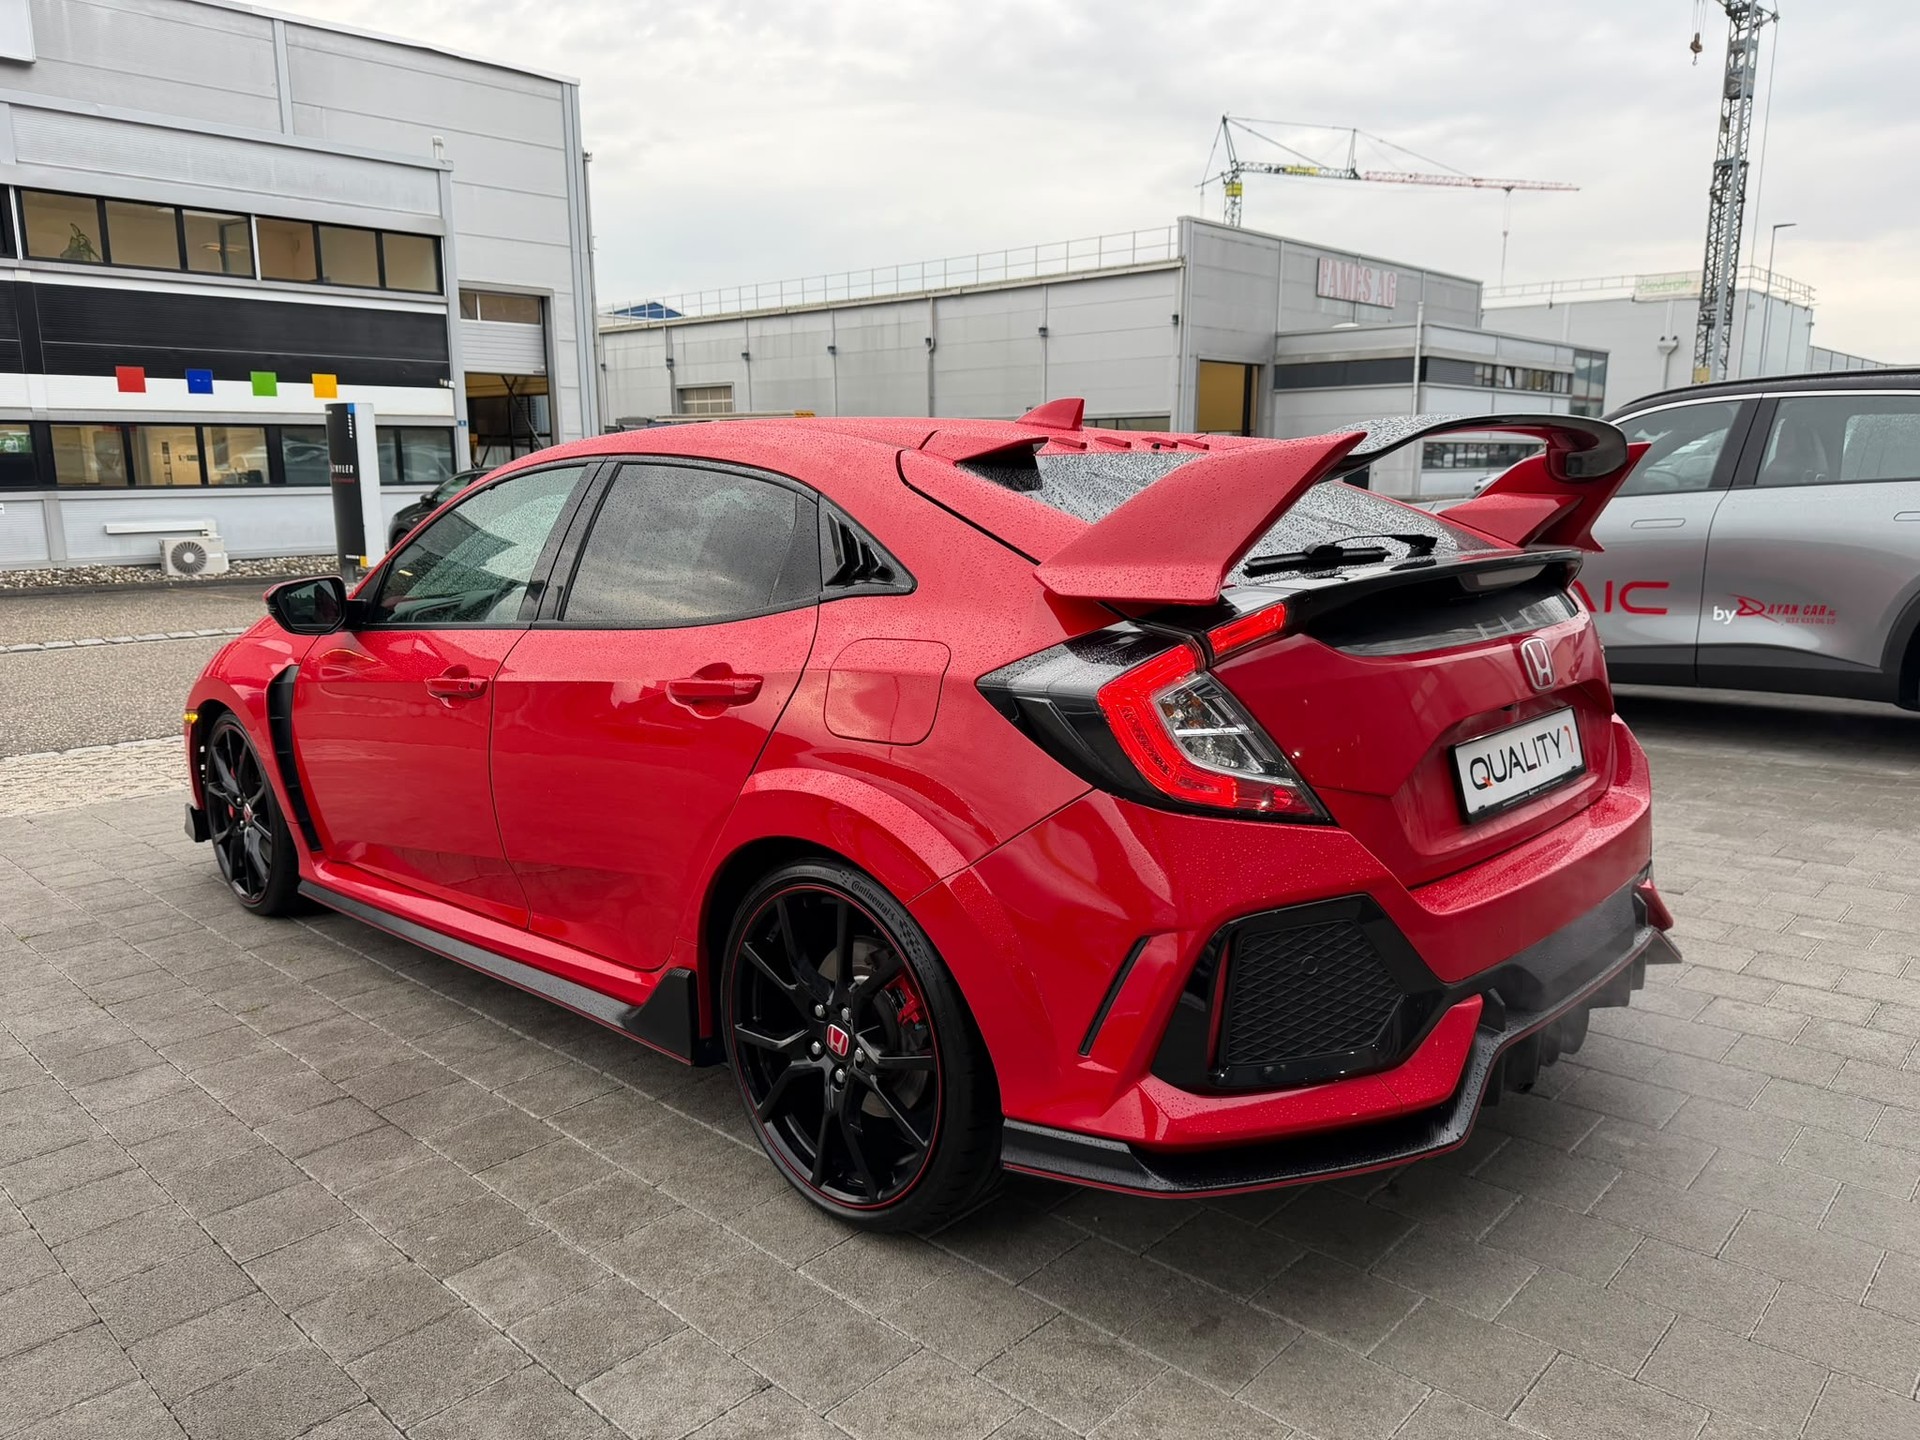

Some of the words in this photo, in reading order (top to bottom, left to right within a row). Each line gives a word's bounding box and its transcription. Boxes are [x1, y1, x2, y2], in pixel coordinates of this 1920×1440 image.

[1378, 270, 1396, 306] AG
[1712, 606, 1736, 625] by
[1803, 604, 1828, 616] CAR
